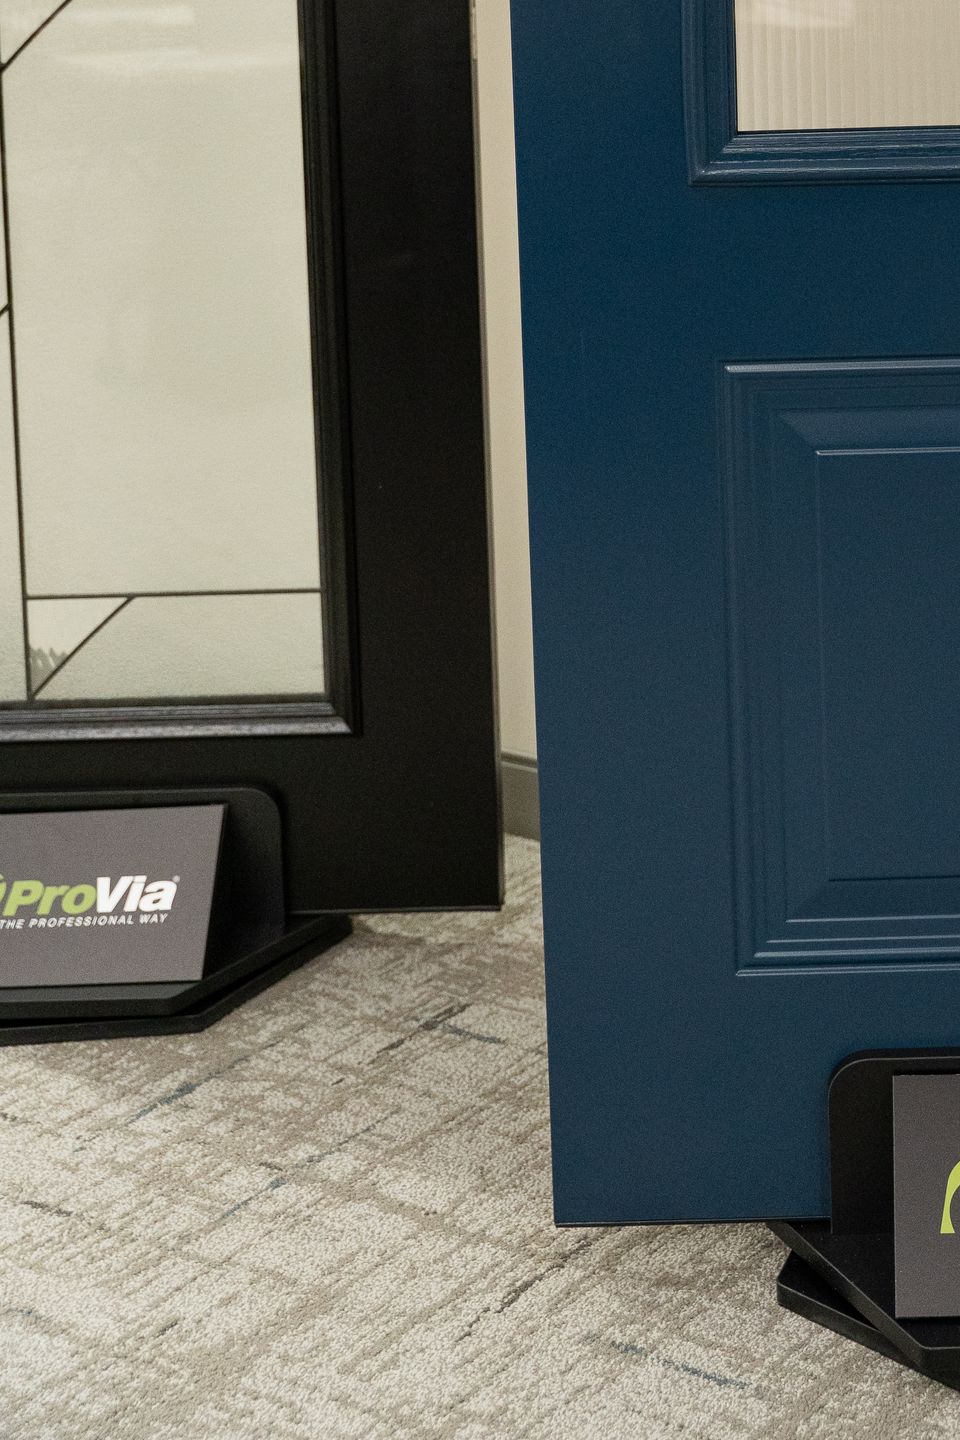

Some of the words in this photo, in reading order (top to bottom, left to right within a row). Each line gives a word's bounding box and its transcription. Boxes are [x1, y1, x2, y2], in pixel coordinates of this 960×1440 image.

[2, 875, 178, 917] ProVia
[0, 919, 26, 930] THE
[28, 915, 135, 929] PROFESSIONAL
[139, 913, 169, 924] WAY
